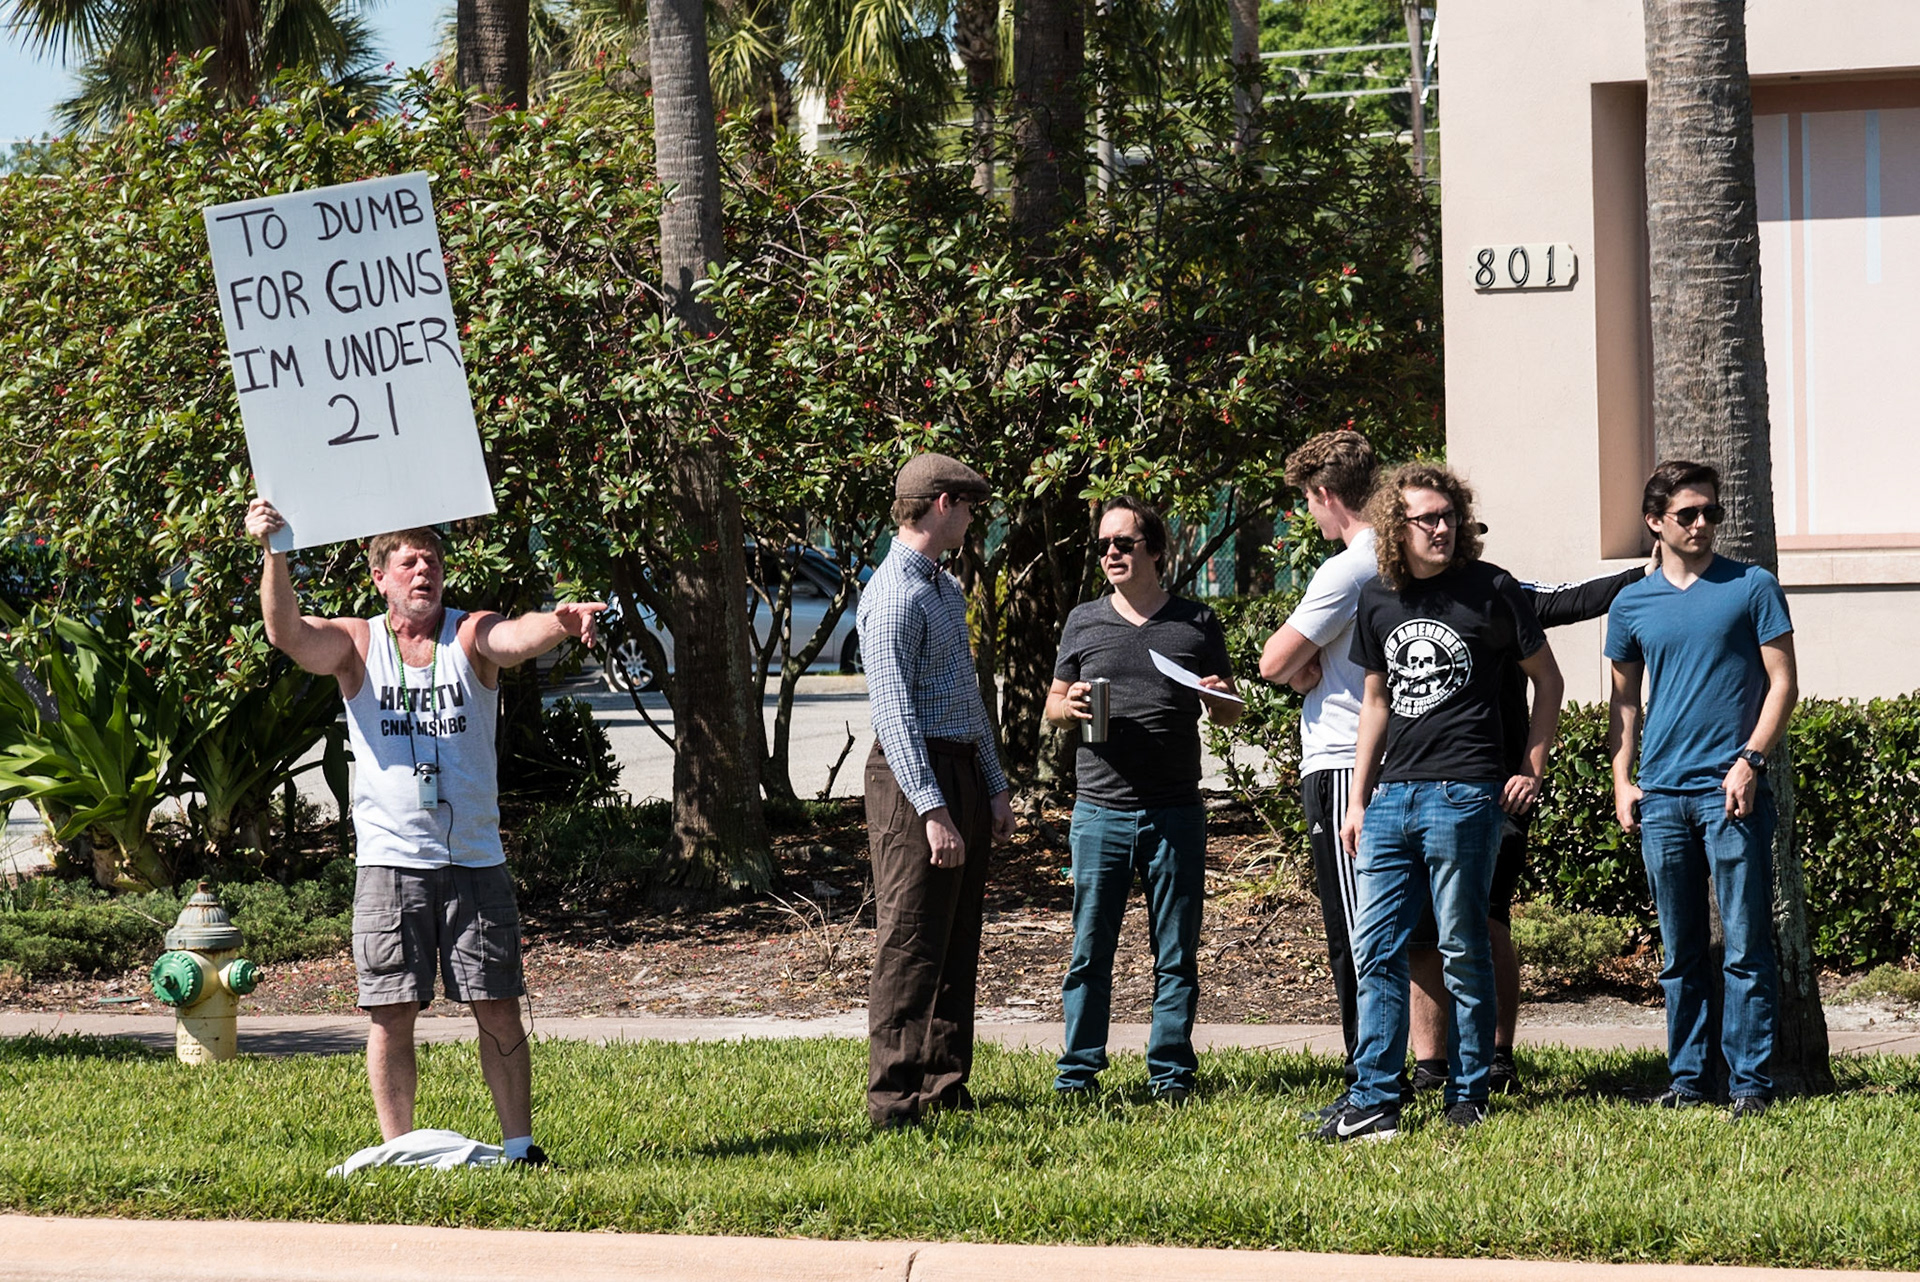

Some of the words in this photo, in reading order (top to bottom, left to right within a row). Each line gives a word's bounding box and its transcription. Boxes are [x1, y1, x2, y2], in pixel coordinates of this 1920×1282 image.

[215, 206, 288, 257] TO
[312, 188, 424, 241] DUMB
[229, 270, 311, 331] FOR
[325, 248, 443, 314] GUNS
[1475, 244, 1556, 289] 801
[233, 345, 305, 394] I'M
[324, 317, 462, 381] UNDER
[327, 382, 400, 446] 21
[1396, 622, 1468, 671] AMENDMENT
